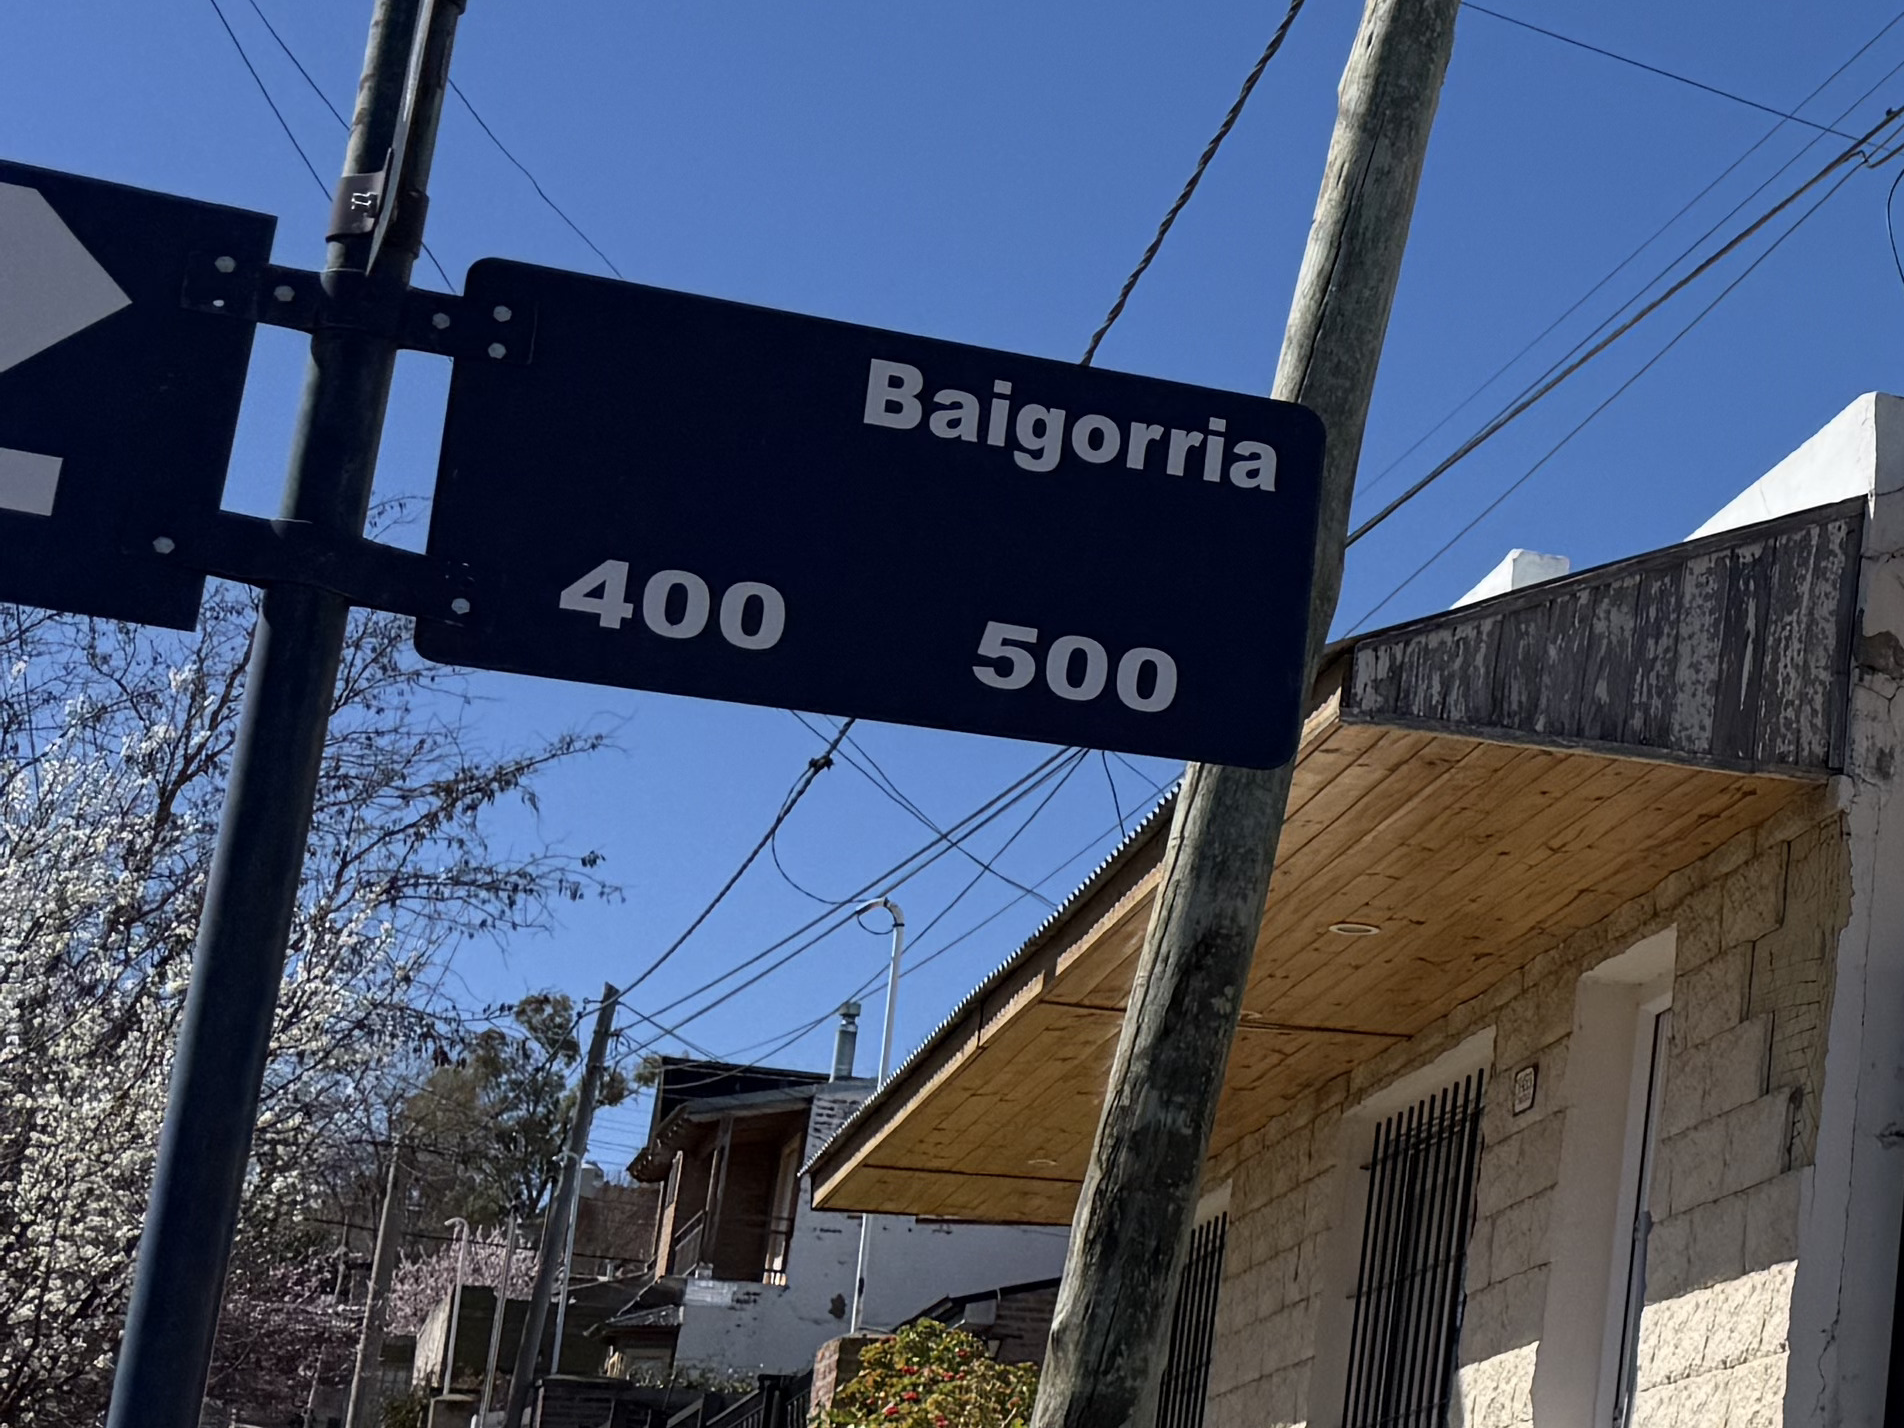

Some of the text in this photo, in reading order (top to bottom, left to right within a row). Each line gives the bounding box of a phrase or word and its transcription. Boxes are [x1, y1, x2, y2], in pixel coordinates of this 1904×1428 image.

[863, 358, 1278, 492] Baigorria
[559, 559, 1178, 713] 400 500
